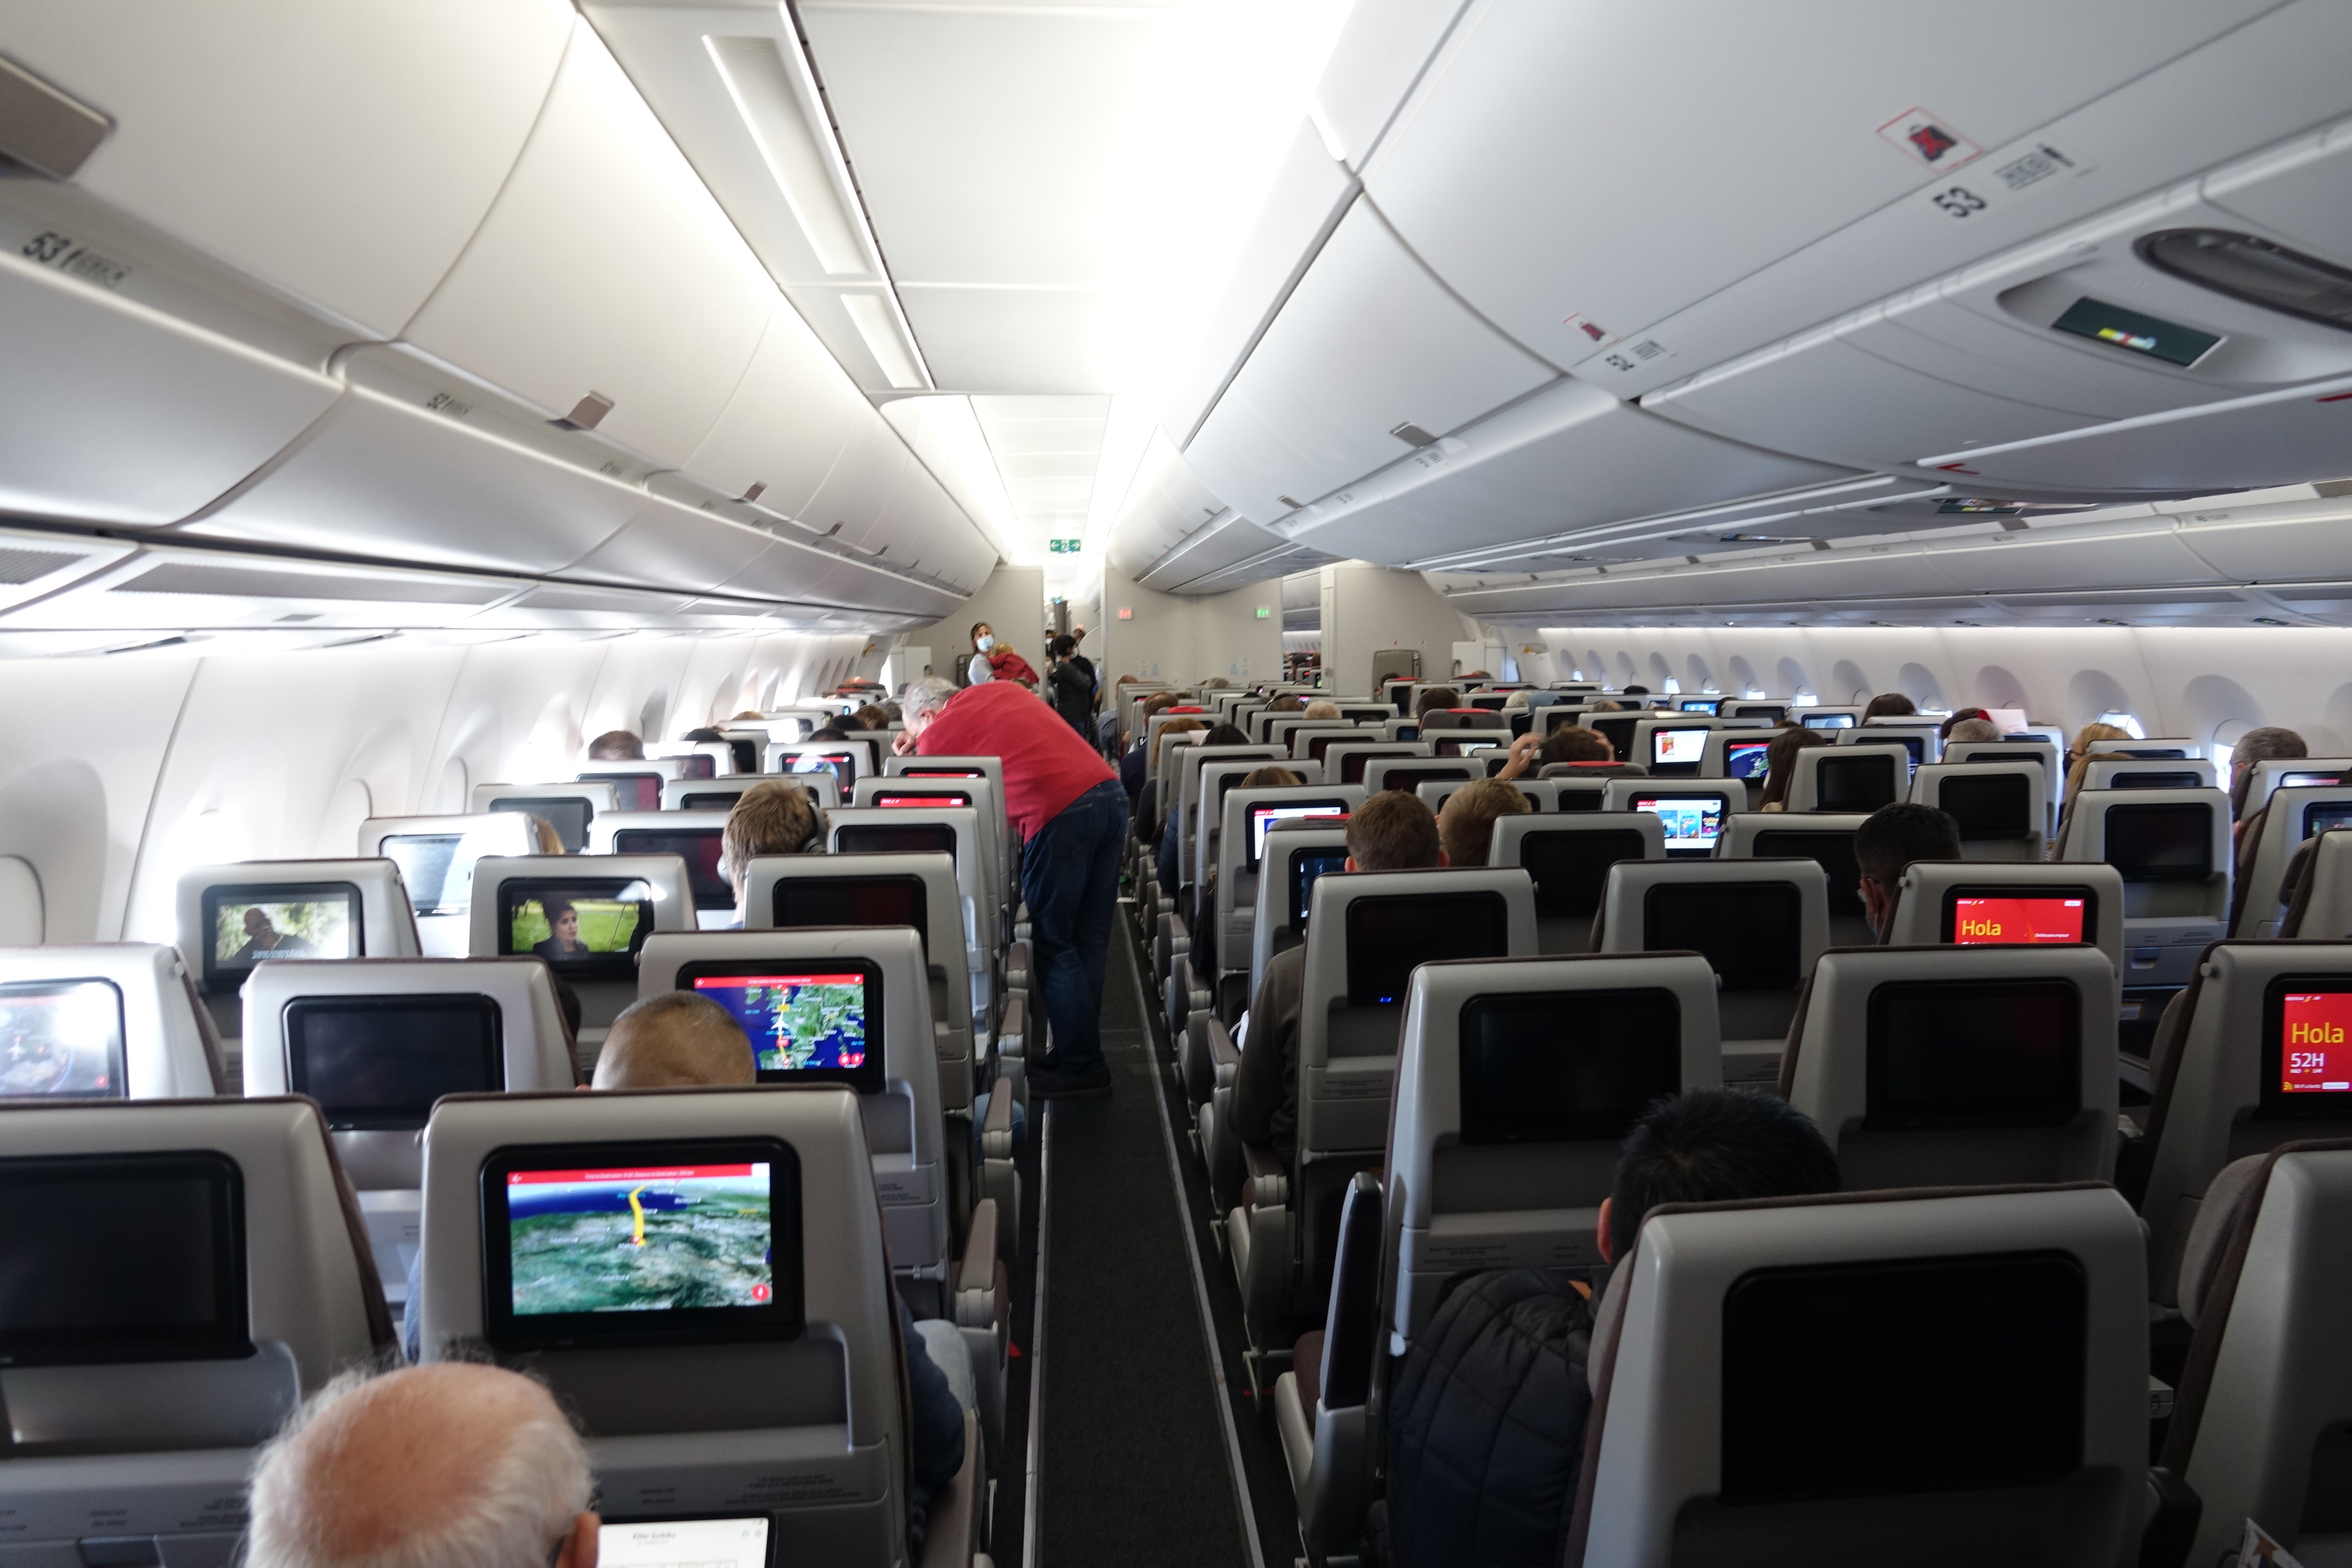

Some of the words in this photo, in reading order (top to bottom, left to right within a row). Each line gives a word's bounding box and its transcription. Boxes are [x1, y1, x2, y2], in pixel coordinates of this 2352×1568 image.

[1932, 186, 1988, 218] 53
[23, 232, 71, 263] 53
[1961, 919, 2002, 936] Hola
[2292, 1022, 2345, 1044] Hola
[2290, 1053, 2325, 1067] 52H
